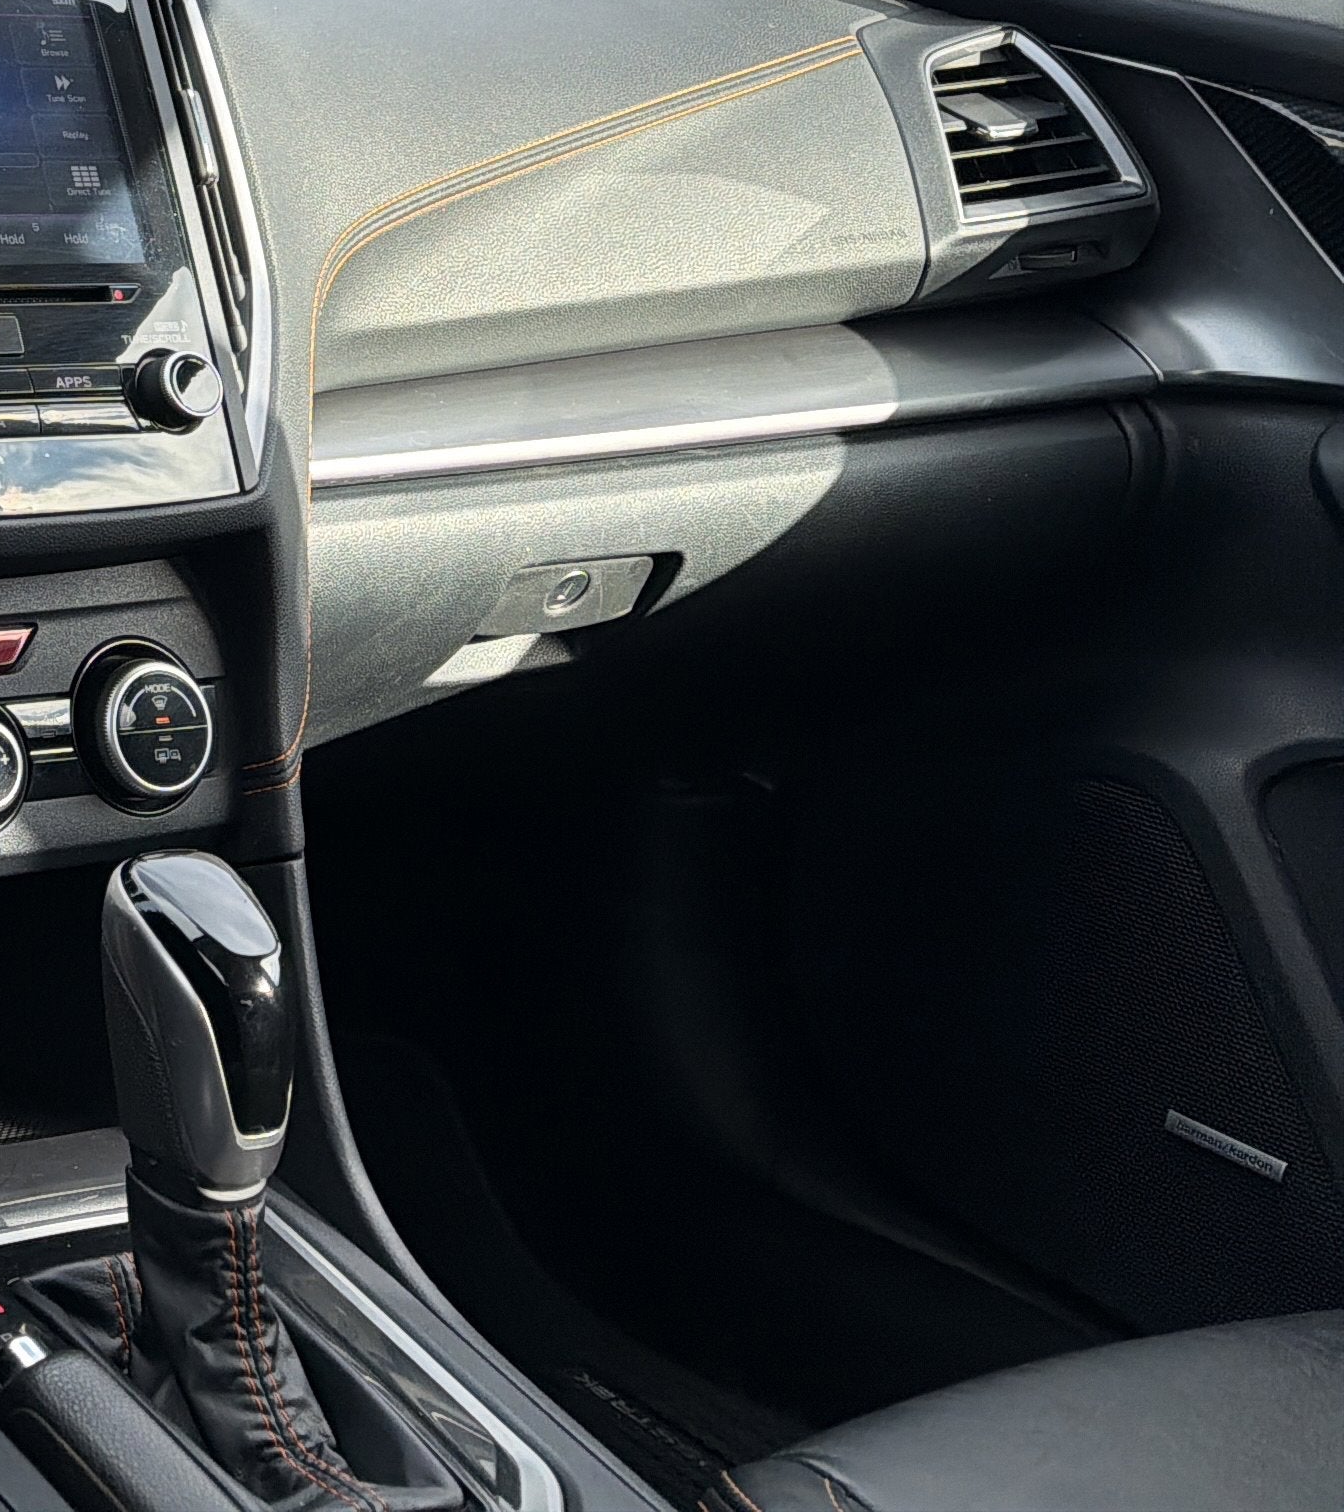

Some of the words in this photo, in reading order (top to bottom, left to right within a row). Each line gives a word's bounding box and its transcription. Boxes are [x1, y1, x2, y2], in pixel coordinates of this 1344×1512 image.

[31, 222, 40, 232] 5
[0, 232, 26, 245] Hold
[63, 231, 89, 245] Hold
[55, 375, 92, 389] APPS
[144, 684, 172, 694] MODE
